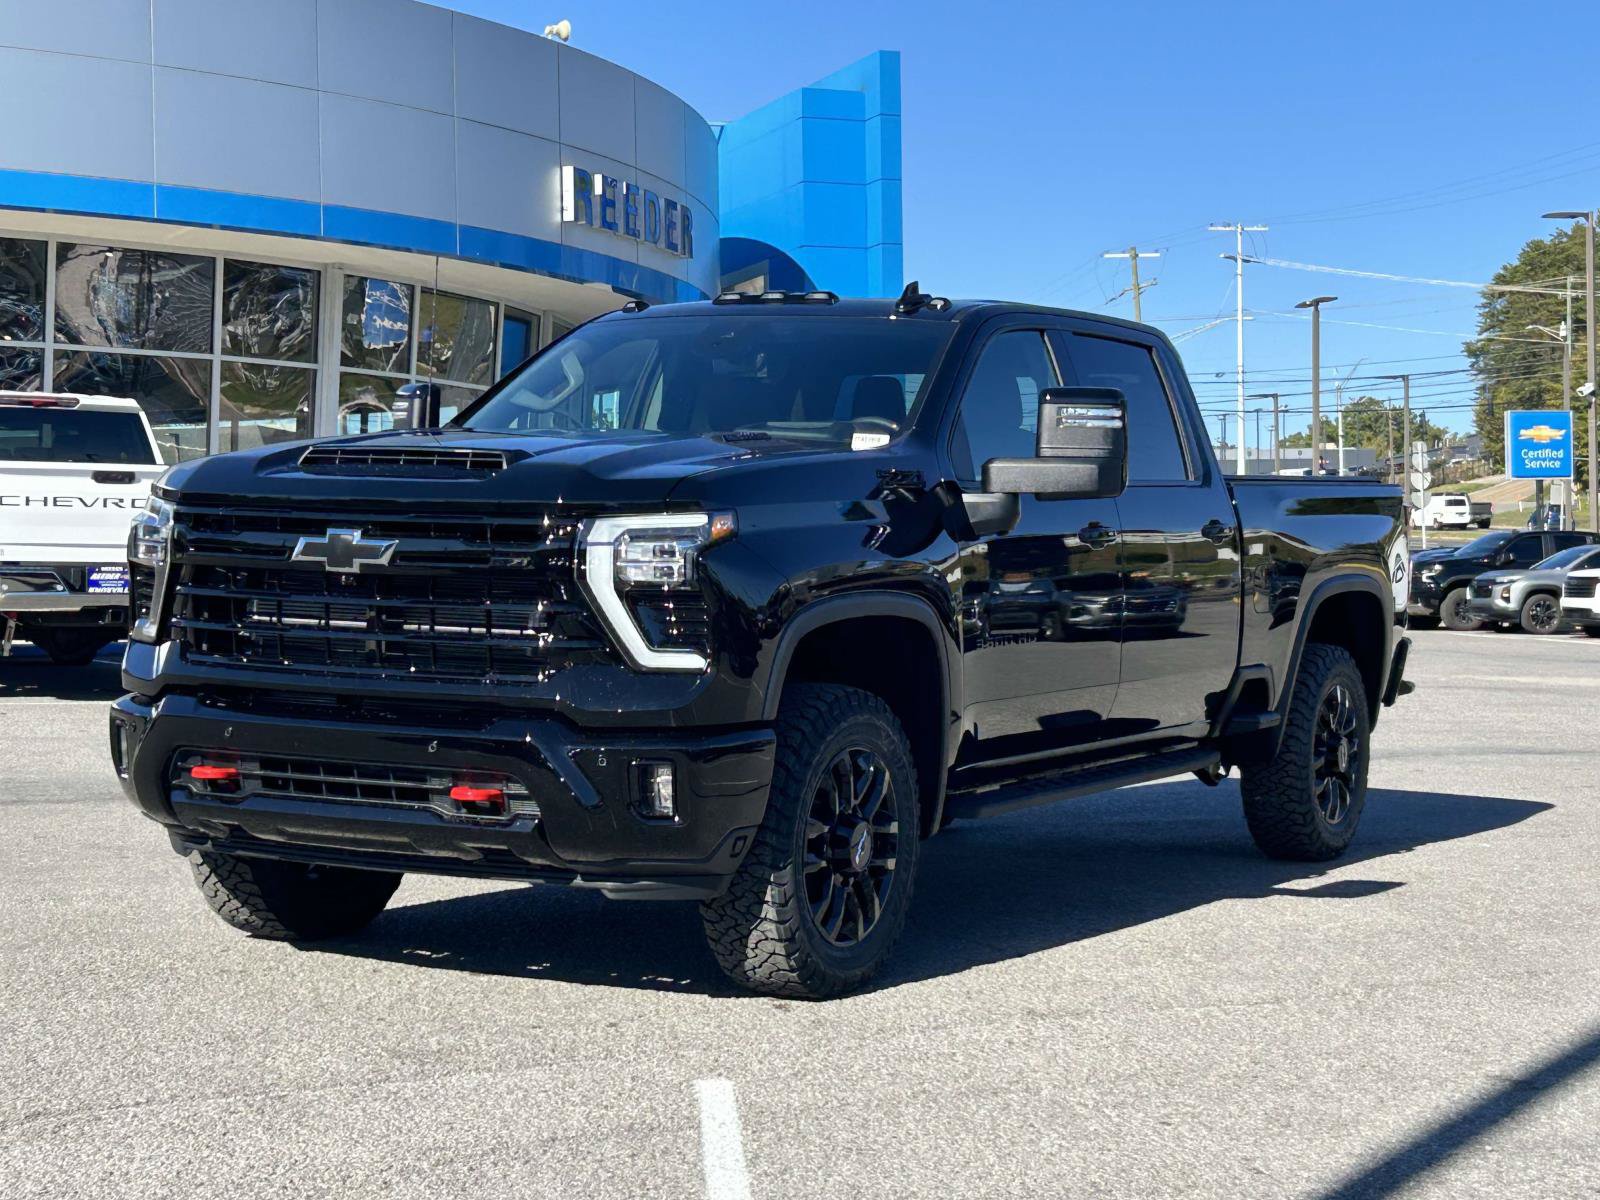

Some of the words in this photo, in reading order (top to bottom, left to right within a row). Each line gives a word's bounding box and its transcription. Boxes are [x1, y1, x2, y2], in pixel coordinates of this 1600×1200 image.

[562, 165, 694, 259] REEDER
[1521, 448, 1564, 459] Certified
[1525, 458, 1561, 469] Service
